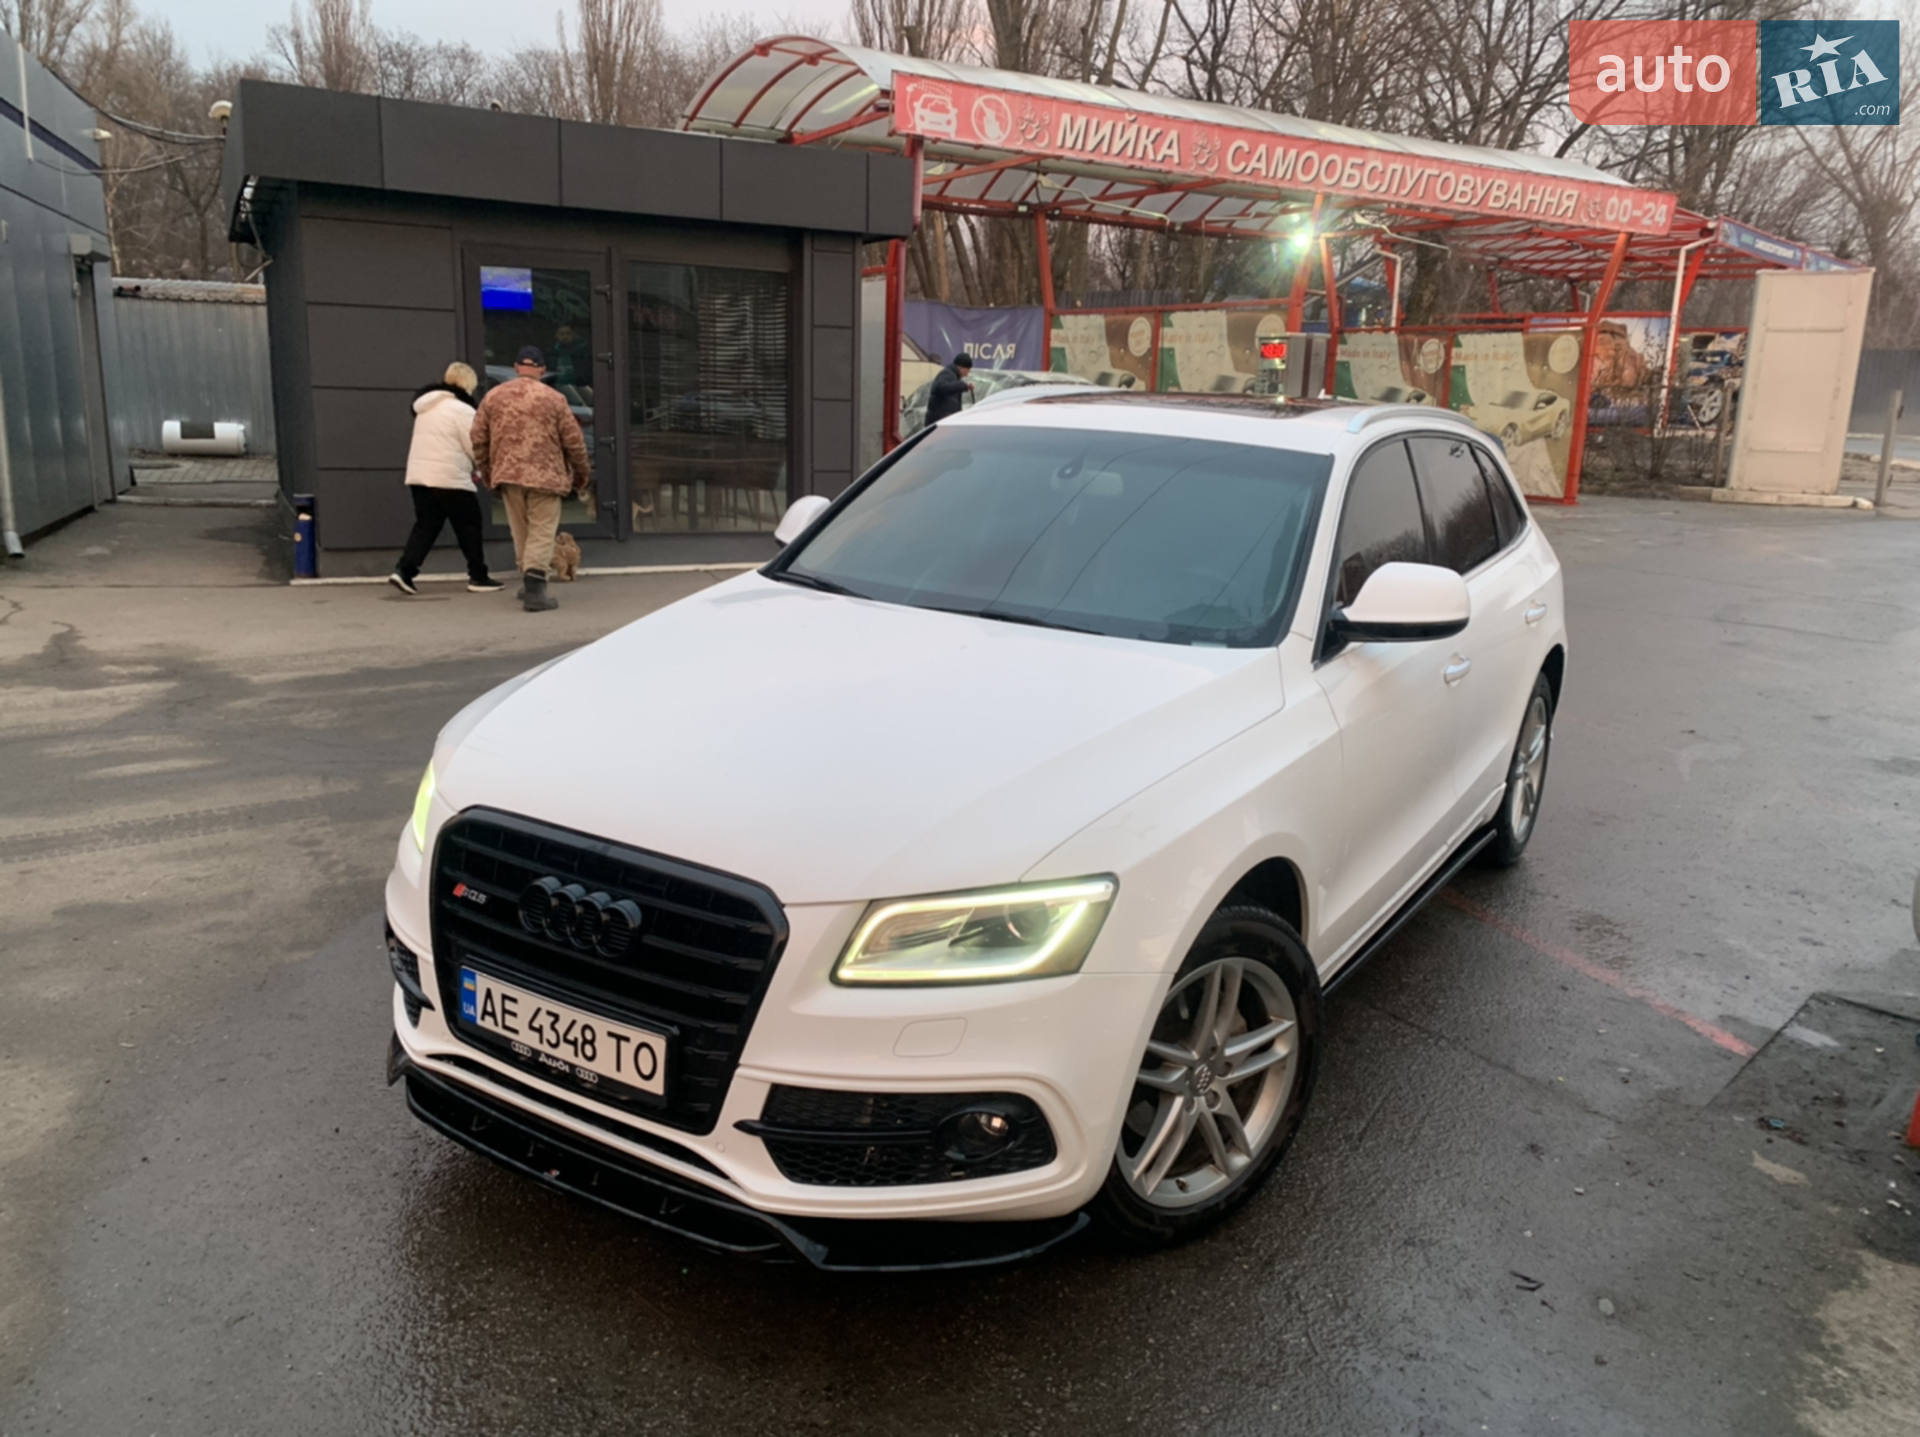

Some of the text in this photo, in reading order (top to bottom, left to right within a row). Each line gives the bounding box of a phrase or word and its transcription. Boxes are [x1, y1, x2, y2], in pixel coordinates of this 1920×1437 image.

[1056, 112, 1668, 227] МИЙКА САМООБСЛУГОВУВАННЯ 00-24
[963, 342, 1016, 360] ПІСЛЯ
[463, 1001, 476, 1017] UA
[480, 987, 657, 1081] AE 4348 TO
[538, 1053, 570, 1073] Audi
